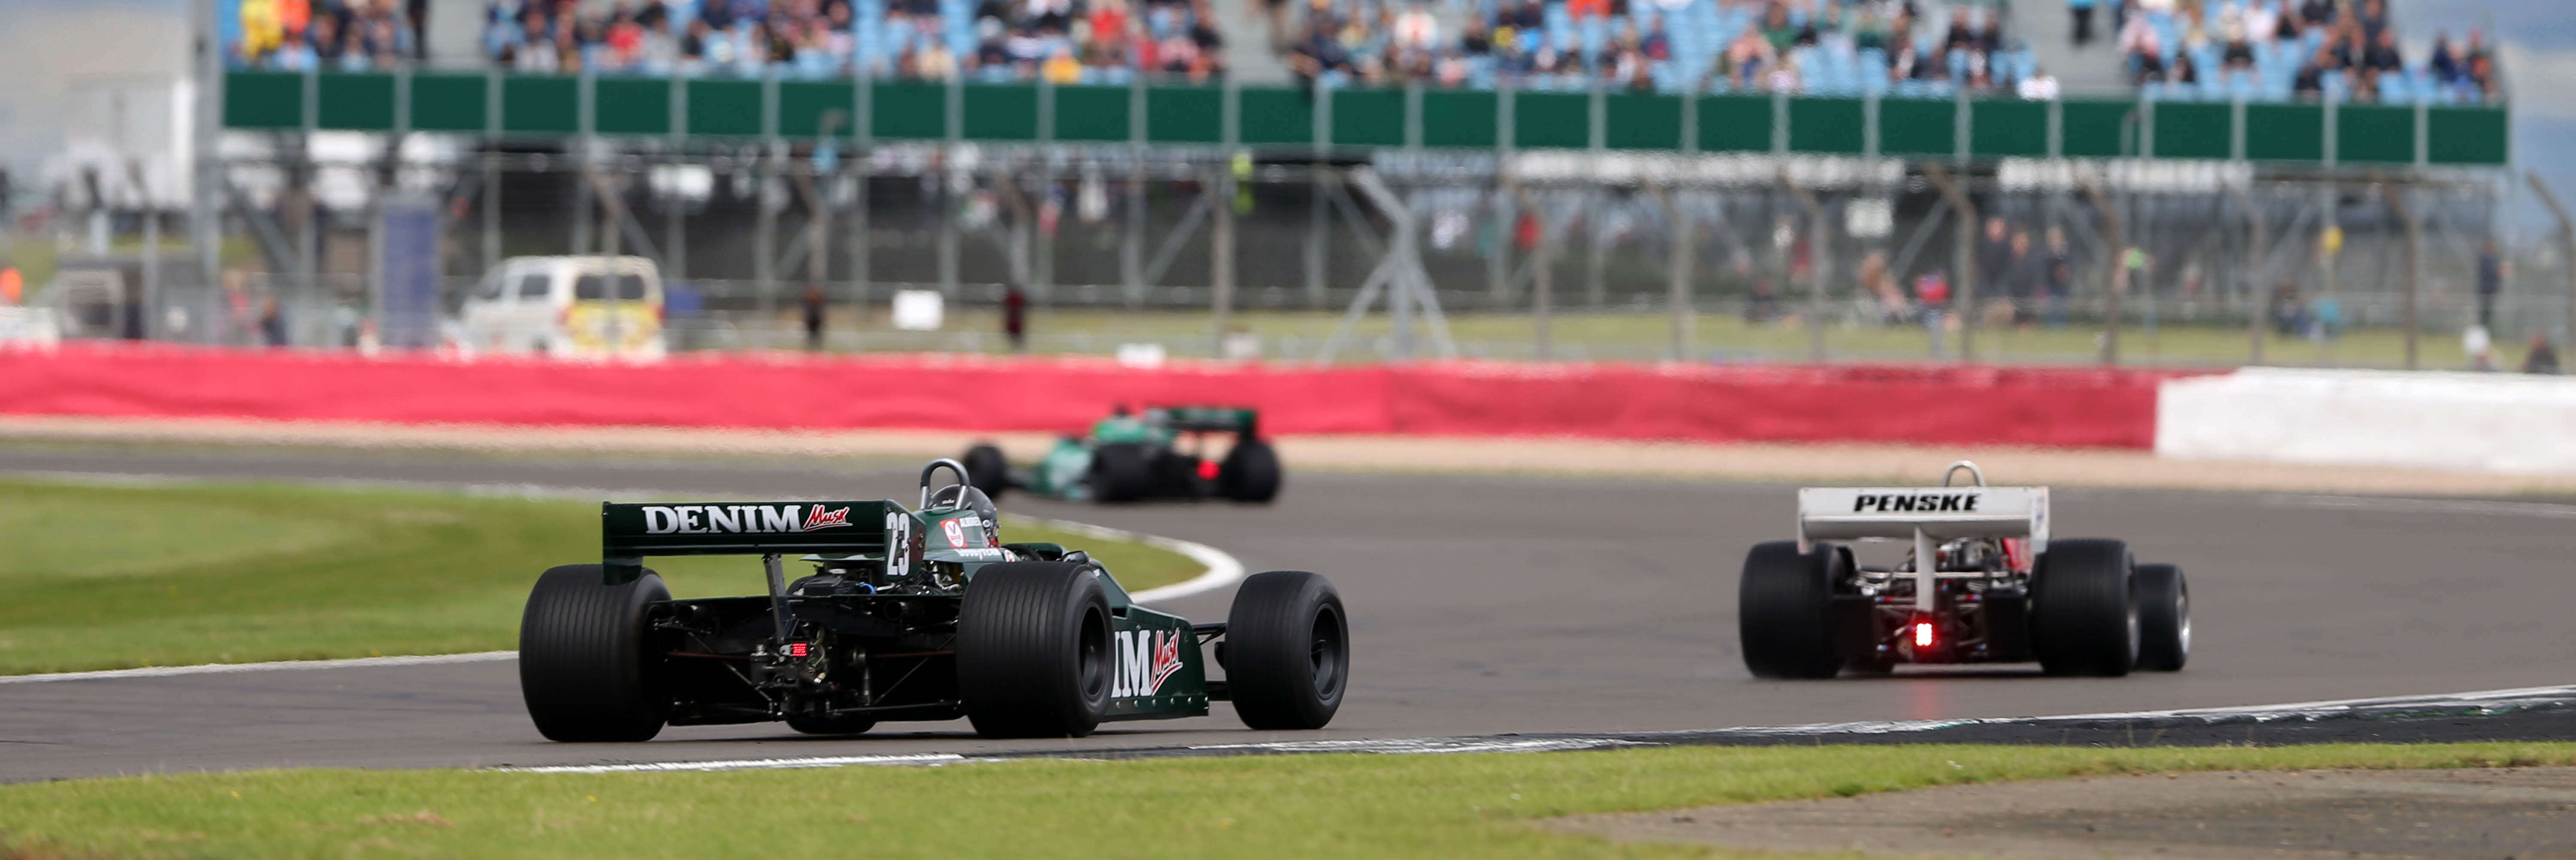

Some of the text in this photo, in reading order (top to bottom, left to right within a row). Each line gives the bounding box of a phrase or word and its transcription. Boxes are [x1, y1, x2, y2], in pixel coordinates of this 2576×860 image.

[1853, 494, 1981, 511] PENSKE
[642, 504, 851, 534] DENIM Musk
[886, 512, 910, 576] 23
